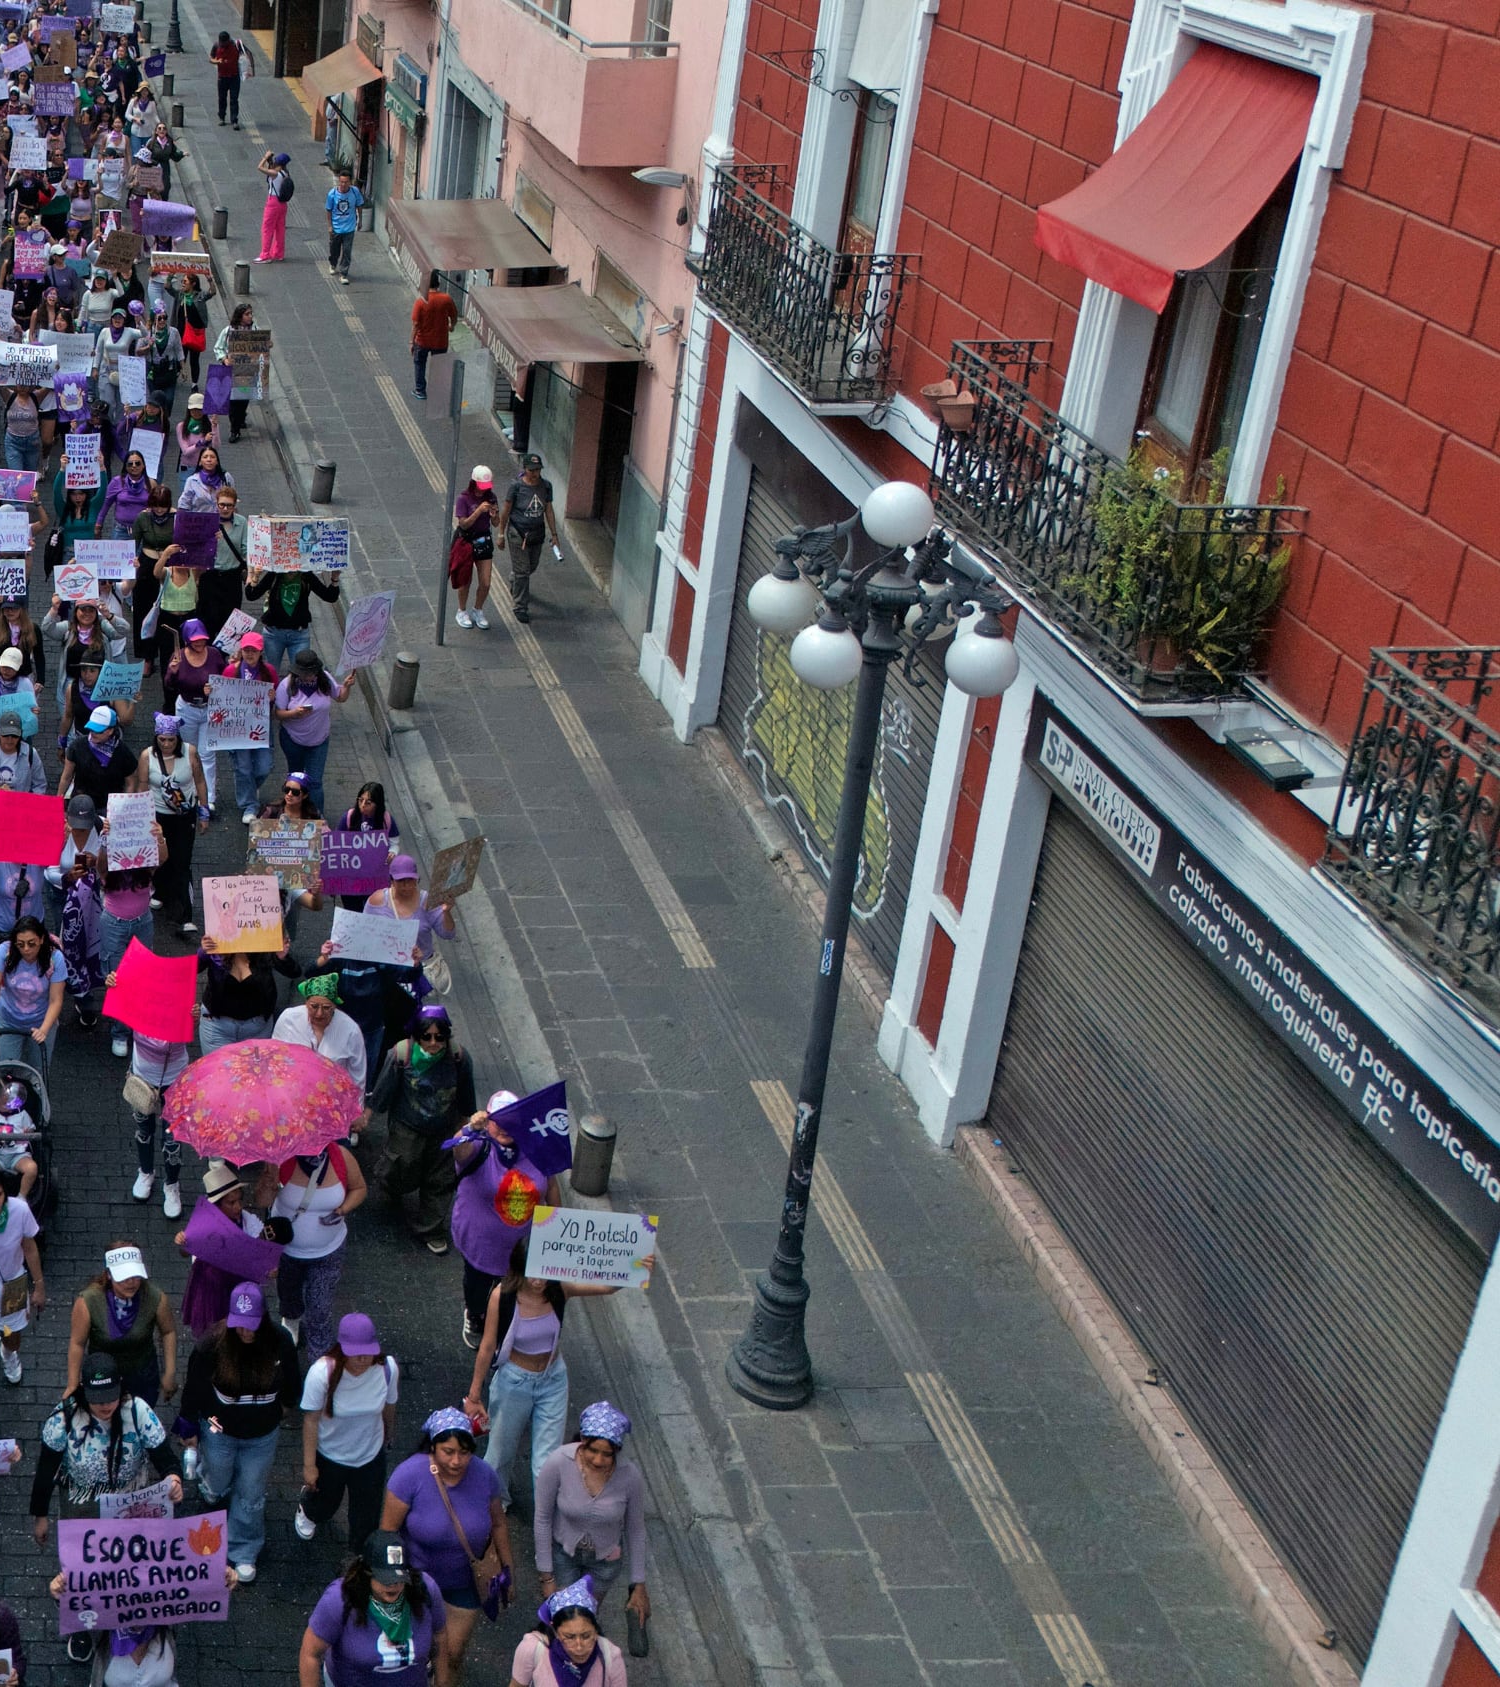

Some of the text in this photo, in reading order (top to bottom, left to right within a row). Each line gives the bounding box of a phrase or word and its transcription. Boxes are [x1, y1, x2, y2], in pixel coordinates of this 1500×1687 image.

[487, 328, 518, 381] VAQUERA
[1077, 756, 1155, 845] SIMIL CUERO
[1074, 775, 1153, 866] PLYMOUTH
[1168, 882, 1396, 1135] calzado, marroquineria Etc.
[1177, 851, 1500, 1203] Fabricamos materiales para tapiceria
[559, 1218, 639, 1244] YO Protesto
[541, 1240, 585, 1255] porque
[581, 1268, 630, 1281] ROMPERME
[105, 1483, 168, 1508] Luchando
[83, 1529, 186, 1563] ESO QUE
[68, 1566, 140, 1593] LLAMAS
[69, 1587, 189, 1611] ES TRABAJO
[118, 1602, 221, 1623] NO PAGADO
